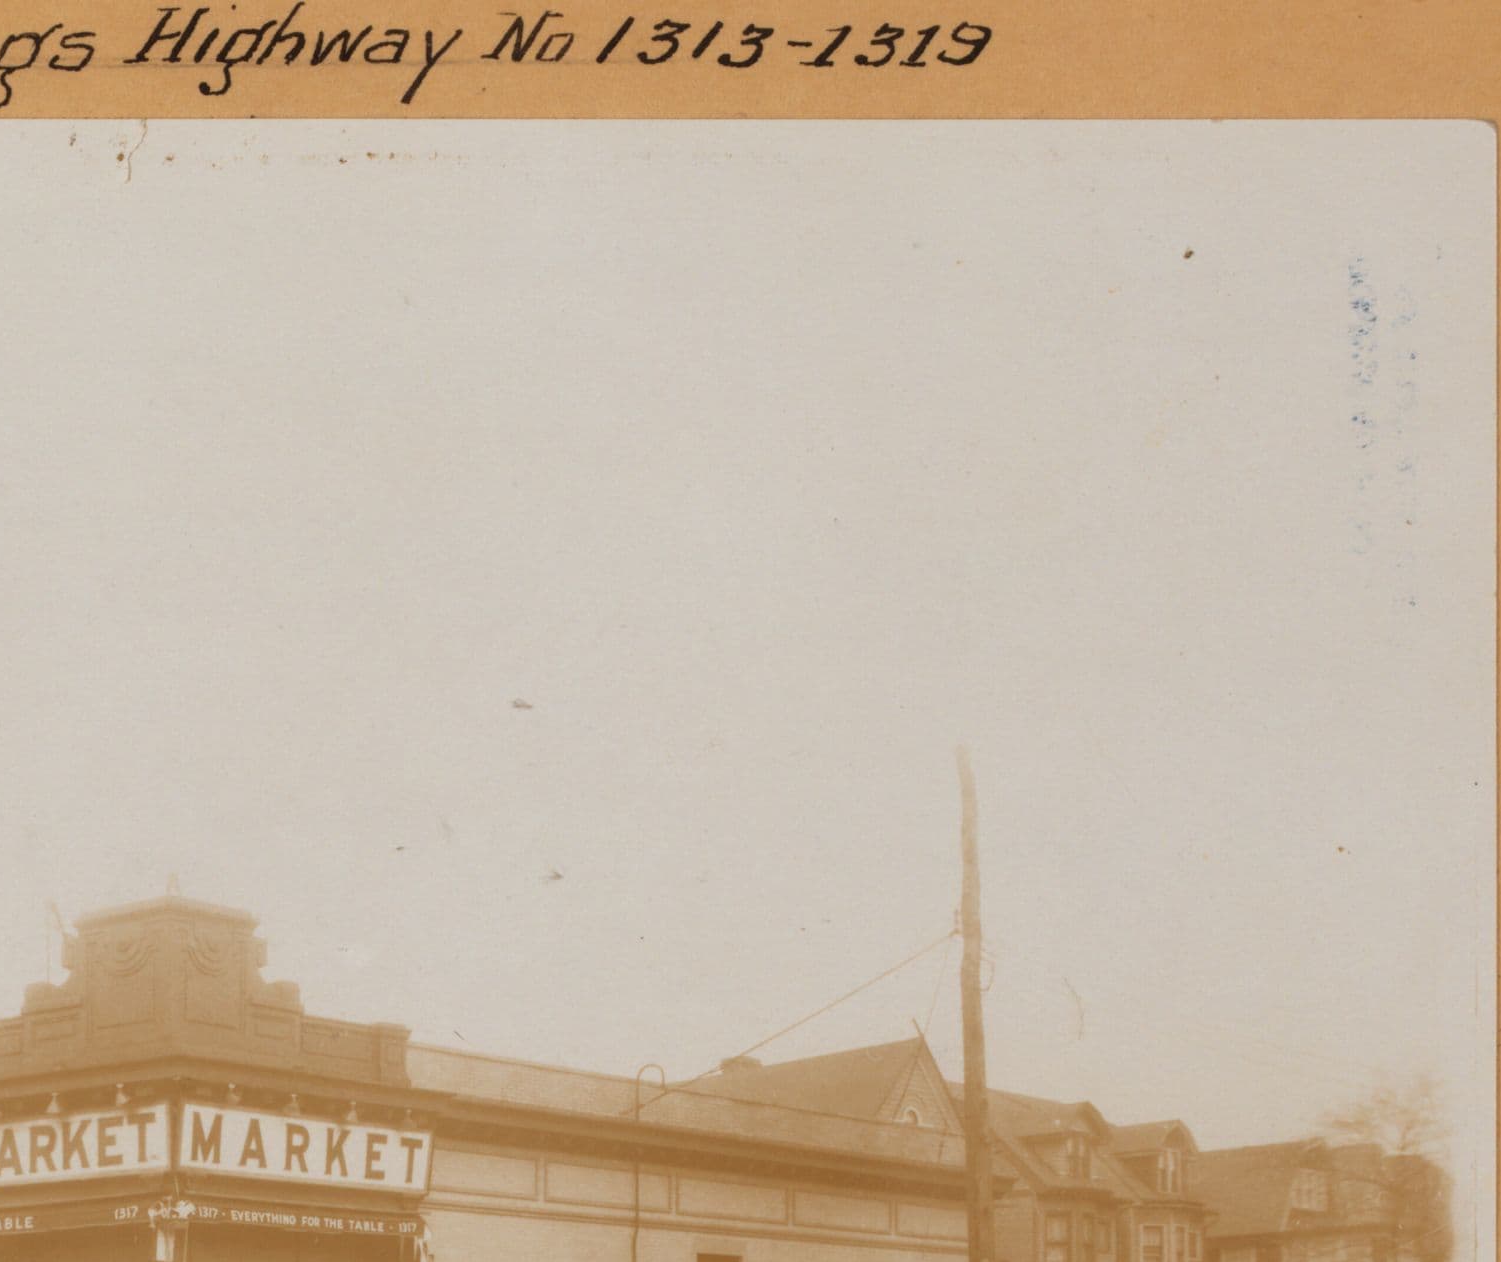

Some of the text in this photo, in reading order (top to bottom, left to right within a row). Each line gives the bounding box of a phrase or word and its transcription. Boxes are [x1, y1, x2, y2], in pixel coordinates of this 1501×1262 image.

[124, 3, 460, 104] Highway
[483, 8, 578, 62] No
[189, 1111, 425, 1185] MARKET
[230, 1209, 297, 1226] EVERYTHING
[301, 1214, 321, 1228] FOR
[323, 1217, 344, 1230] THE
[349, 1219, 385, 1233] TABLE
